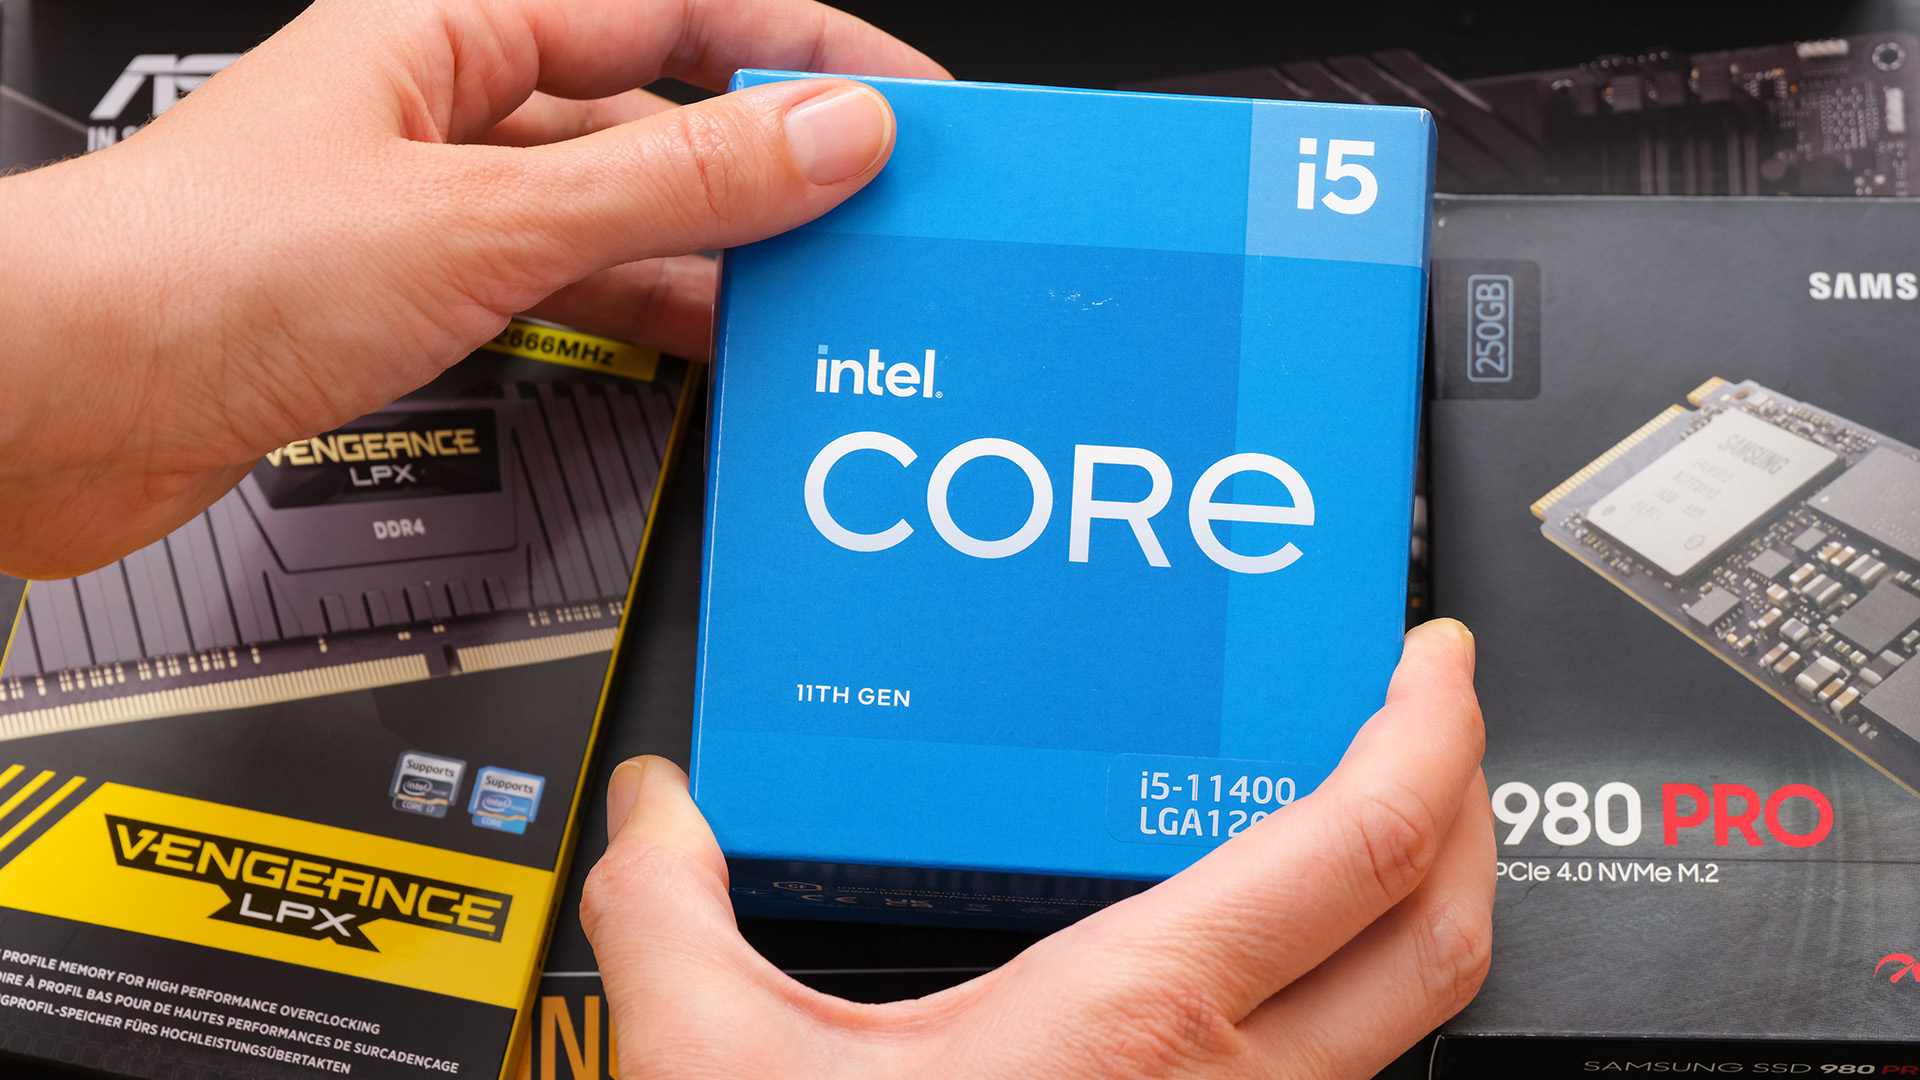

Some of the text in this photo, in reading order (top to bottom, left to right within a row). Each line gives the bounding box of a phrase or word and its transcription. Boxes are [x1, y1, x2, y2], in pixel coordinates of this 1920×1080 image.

[1297, 137, 1378, 215] i5
[1808, 271, 1919, 301] SAMS
[1475, 282, 1506, 374] 250GB
[265, 428, 481, 467] VENGEANCE
[350, 464, 417, 487] LPX
[373, 518, 425, 540] DDR4
[797, 684, 910, 707] 11TH GEN
[406, 759, 455, 777] Supports
[484, 775, 534, 793] Supports
[1140, 771, 1296, 806] i5-11400
[1140, 806, 1270, 838] LGA12
[1491, 781, 1834, 848] 980 PRO
[116, 823, 503, 933] VENGEANCE
[1556, 862, 1592, 882] 4.0
[1598, 863, 1672, 883] NVMe
[1678, 863, 1719, 884] M.2
[239, 892, 357, 938] LPX
[2, 949, 381, 1035] PROFILE MEMORY FOR HIGH PERFORMANCE OVERCLOCKING
[0, 970, 460, 1074] IRE À PROFIL BAS POUR DE HAUTES PERFORMANCES DE SURCADENÇAGE
[124, 1018, 158, 1036] FÜRS
[160, 1026, 352, 1075] HOCHLEISTUNGSÜBERTAKTEN
[1583, 1061, 1744, 1074] SAMSUNG
[1752, 1062, 1811, 1074] SSD
[1820, 1063, 1875, 1075] 980
